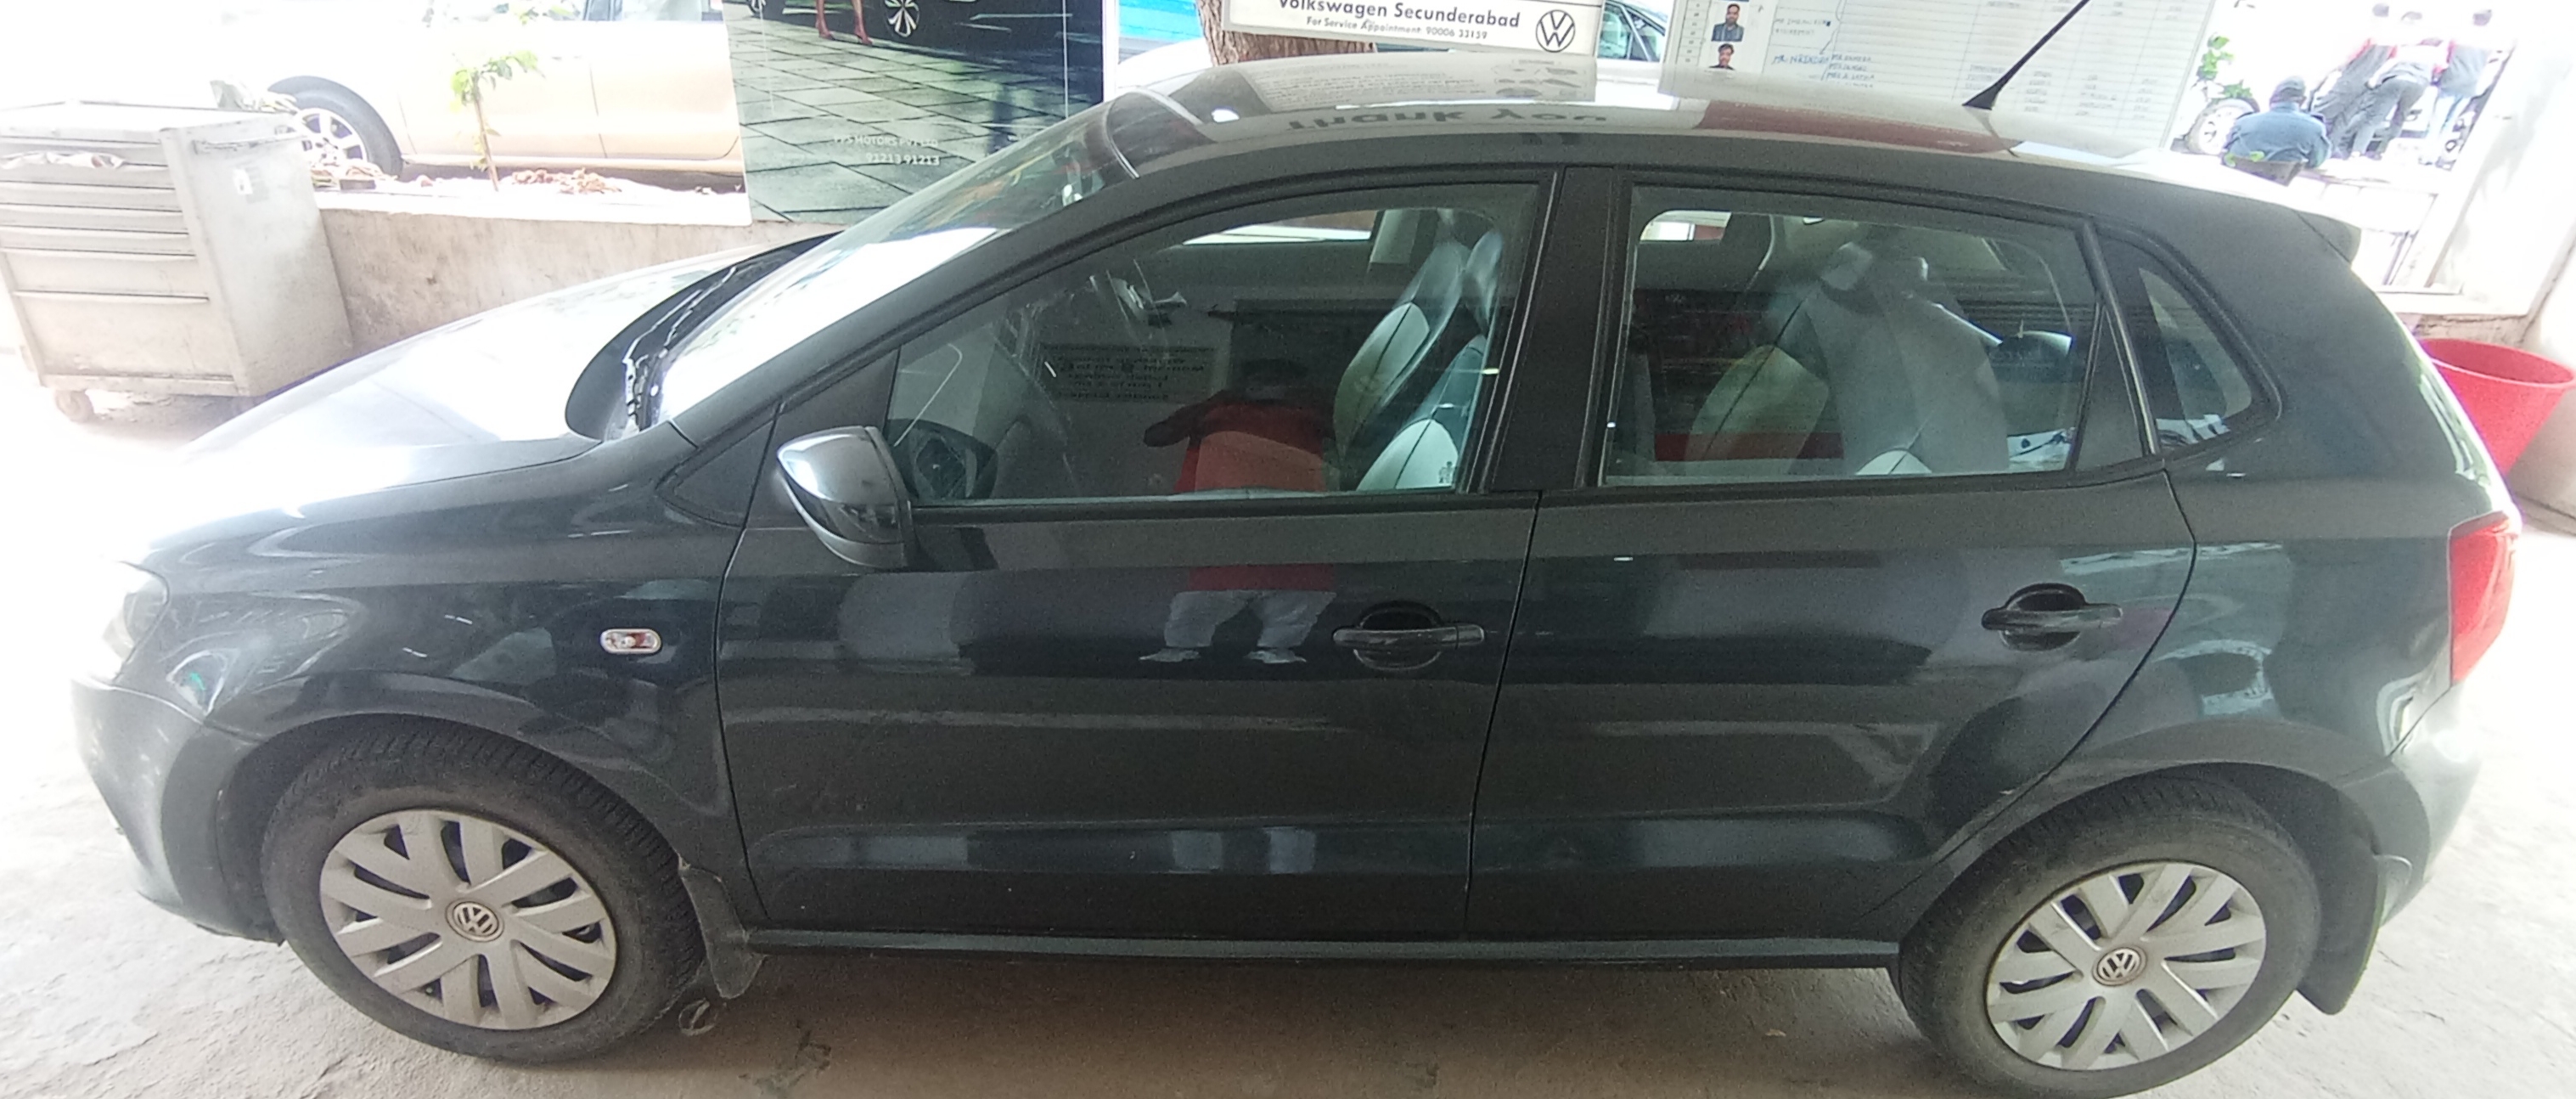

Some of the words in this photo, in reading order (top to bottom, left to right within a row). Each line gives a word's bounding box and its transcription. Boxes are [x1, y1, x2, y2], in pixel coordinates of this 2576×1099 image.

[1393, 3, 1520, 28] Secunderabad
[1307, 16, 1321, 25] For
[1324, 18, 1358, 29] Service
[866, 152, 902, 164] 91213
